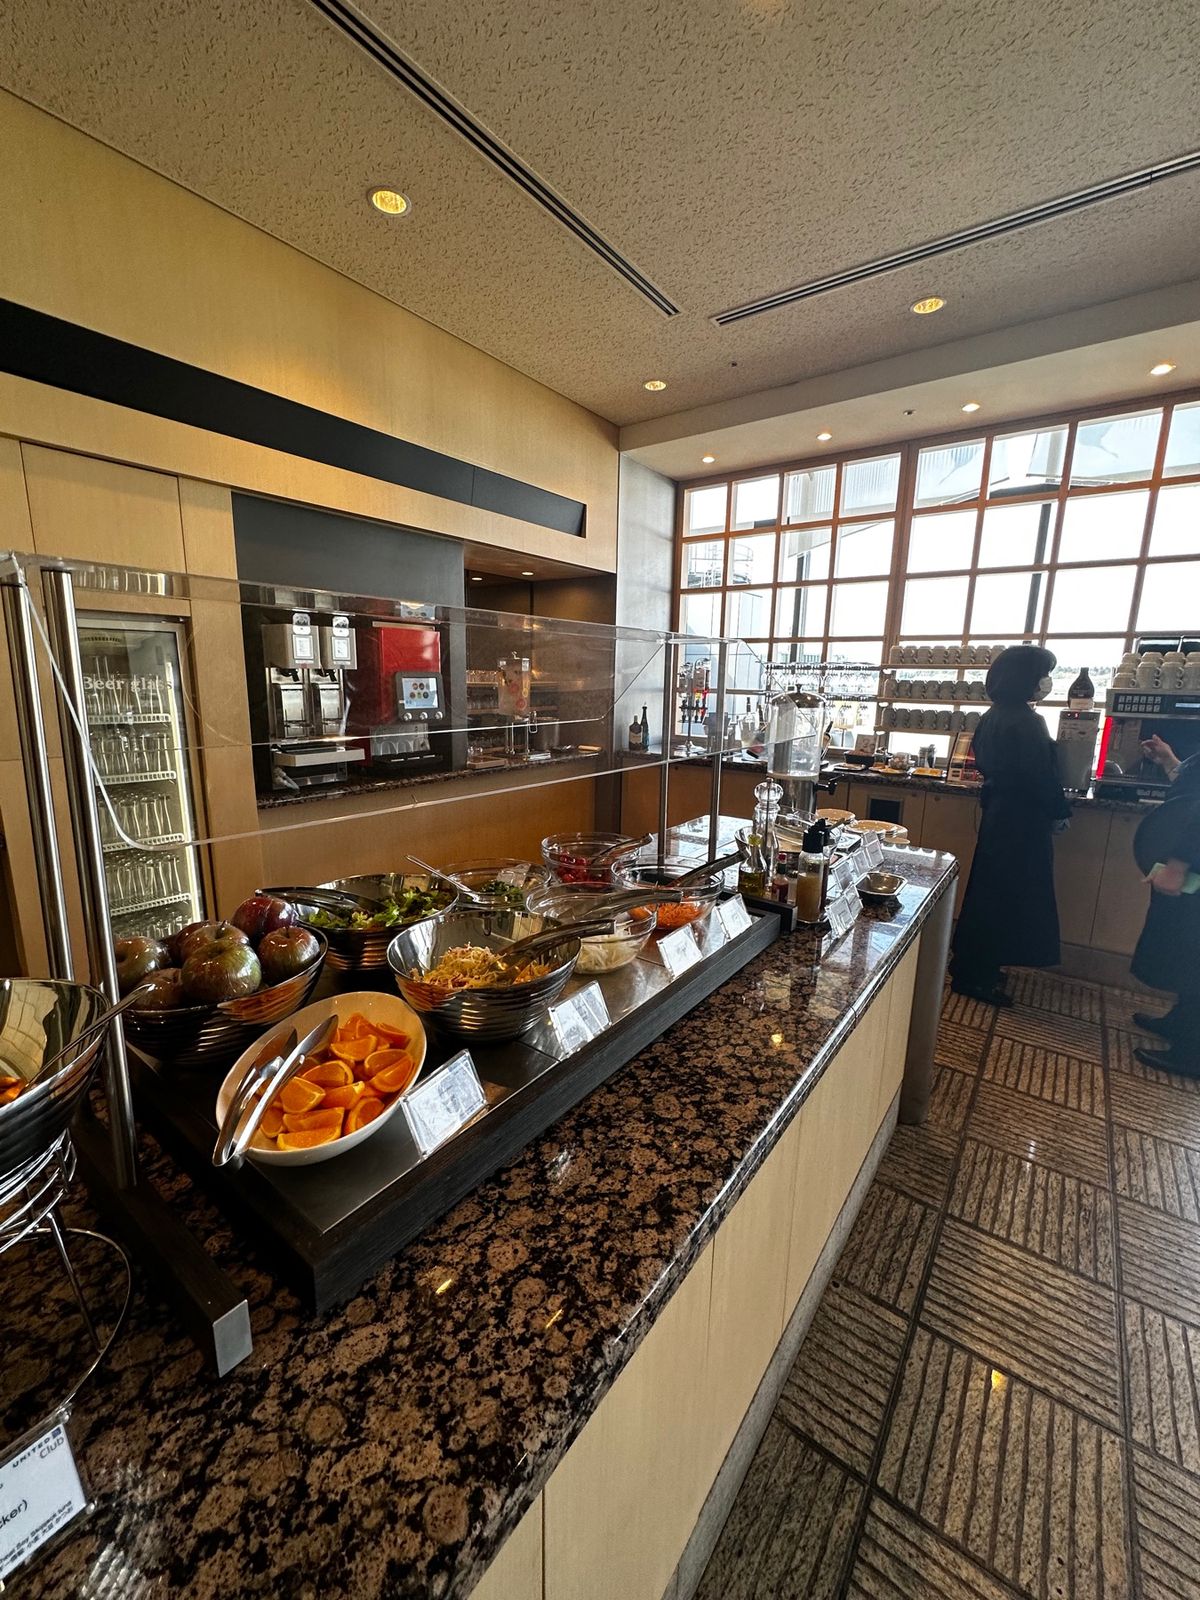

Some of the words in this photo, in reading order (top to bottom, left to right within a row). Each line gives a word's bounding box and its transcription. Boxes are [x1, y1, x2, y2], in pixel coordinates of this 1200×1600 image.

[83, 676, 124, 690] Beer
[131, 677, 174, 692] glass
[12, 1437, 50, 1468] UNITED
[39, 1436, 64, 1459] Club
